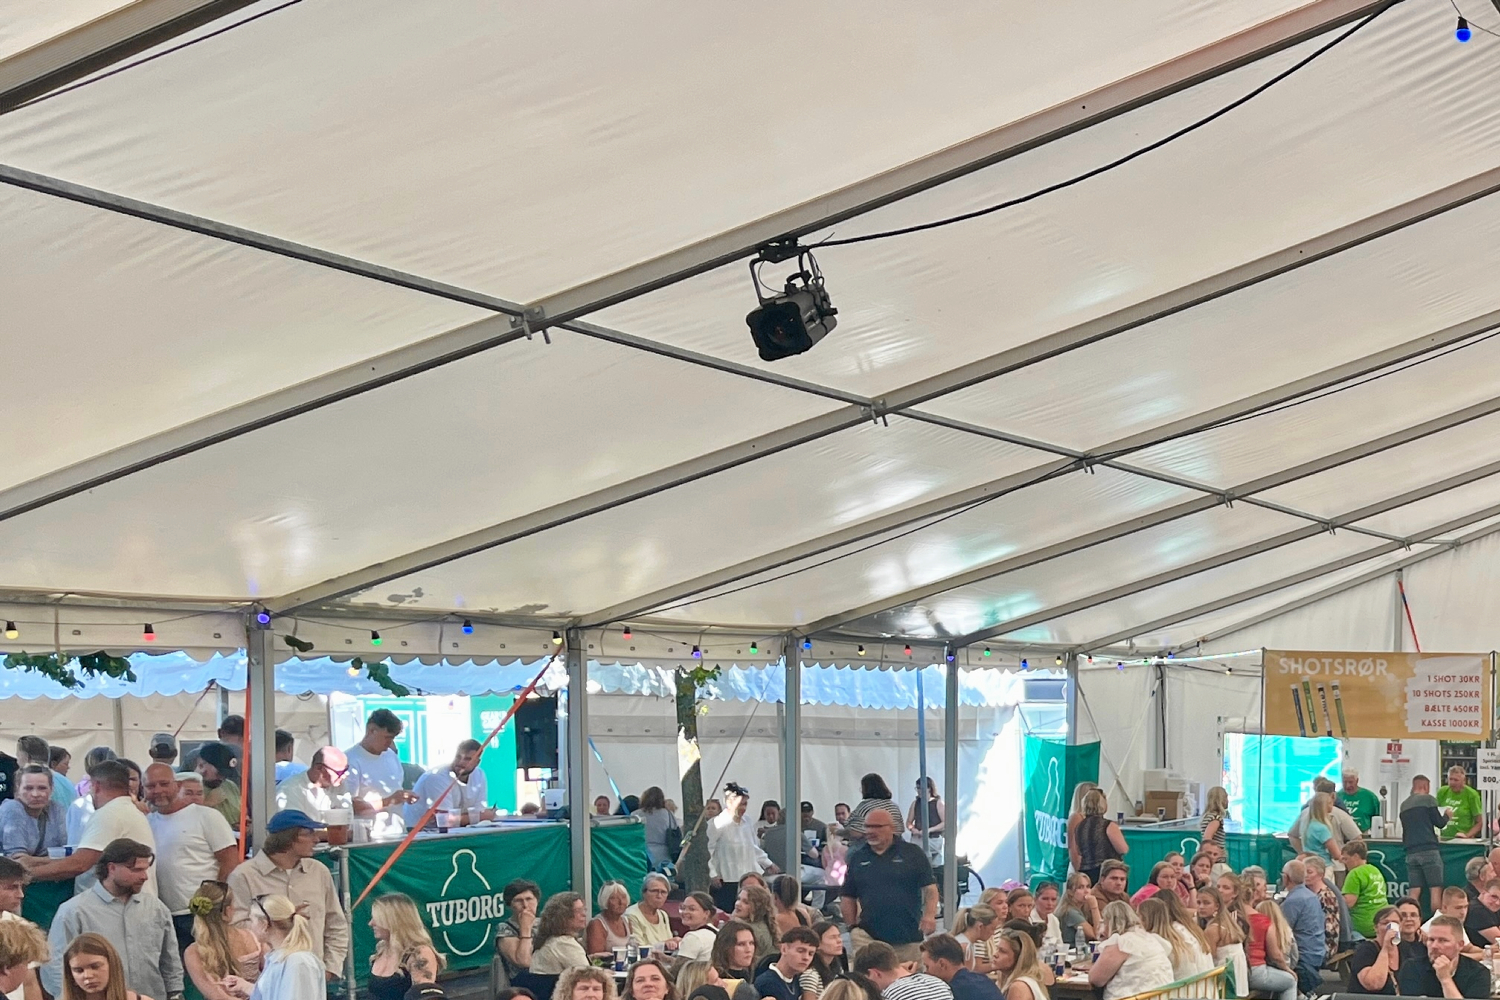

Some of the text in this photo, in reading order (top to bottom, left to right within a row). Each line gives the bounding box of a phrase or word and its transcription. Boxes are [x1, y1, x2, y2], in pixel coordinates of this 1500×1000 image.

[1279, 657, 1388, 676] SHOTSRØR
[1433, 675, 1457, 683] SHOT
[1459, 675, 1480, 683] 30KR
[1412, 689, 1480, 699] 10 SHOTS 250KR
[1424, 704, 1480, 713] BÆLTE 450KR
[1421, 719, 1480, 728] KASSE 1000KR
[426, 892, 505, 928] TUBORG
